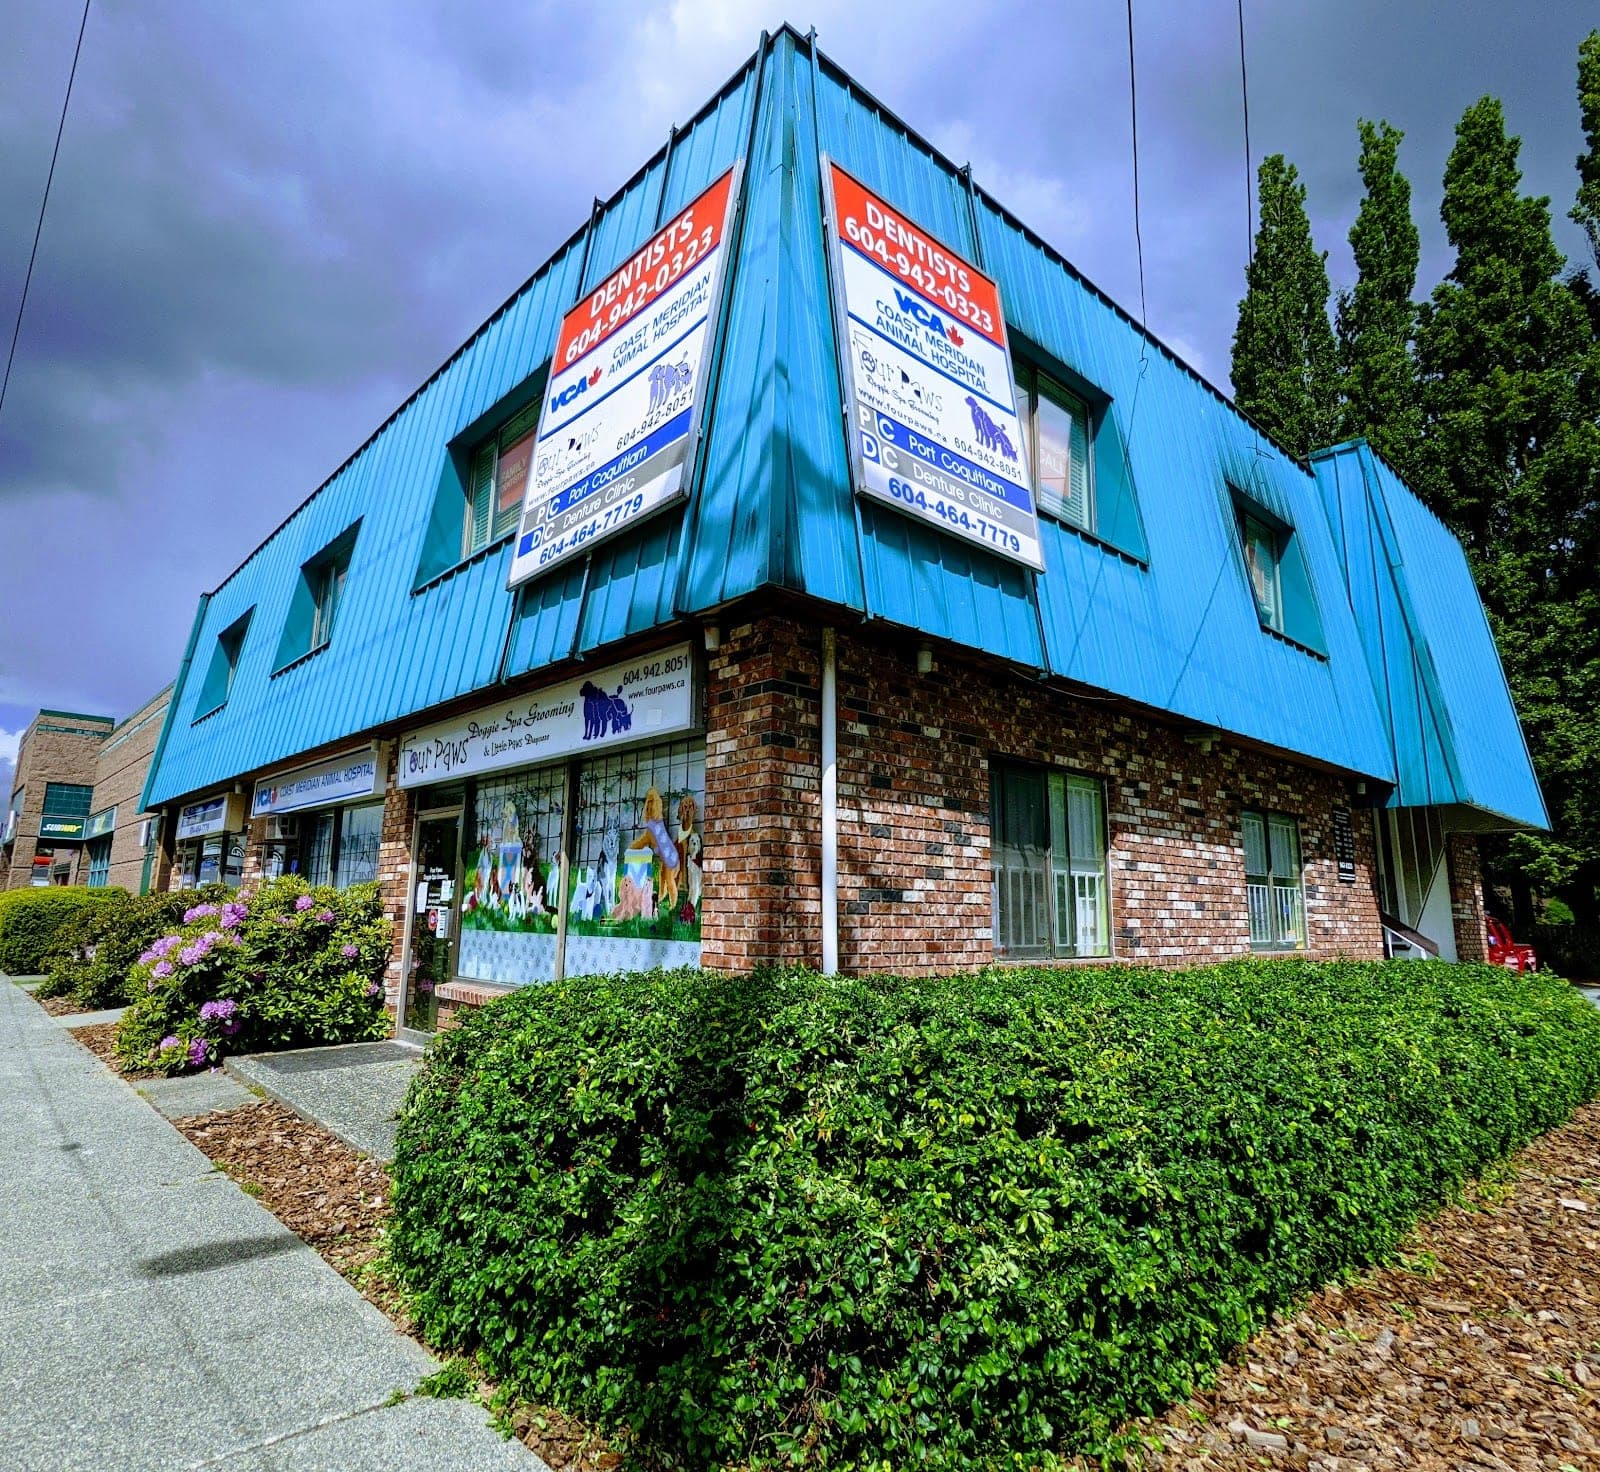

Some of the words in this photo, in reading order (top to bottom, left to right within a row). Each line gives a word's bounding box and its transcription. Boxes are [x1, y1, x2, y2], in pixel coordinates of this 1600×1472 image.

[590, 209, 694, 319] DENTISTS
[845, 216, 994, 333] 604-942-0323
[866, 201, 971, 293] DENTISTS
[565, 225, 714, 362] 604-942-0323
[612, 323, 650, 359] COAST
[652, 271, 711, 329] MERIDIAN
[893, 287, 948, 339] VCA
[607, 339, 648, 378] ANIMAL
[652, 289, 709, 343] HOSPITAL
[876, 300, 919, 337] COAST
[925, 331, 985, 377] MERIDIAN
[876, 316, 928, 357] ANIMAL
[931, 350, 990, 394] HOSPITAL
[551, 376, 588, 413] VCA
[616, 388, 693, 450] 604-942-8051
[568, 482, 589, 505] Port
[591, 445, 648, 489] Coquitlam
[860, 408, 871, 426] P
[879, 419, 895, 440] C
[909, 434, 936, 462] Port
[941, 453, 1006, 497] Coquitlam
[862, 436, 878, 459] D
[882, 447, 898, 469] C
[912, 463, 965, 501] Denture
[969, 492, 1003, 518] Clinic
[954, 437, 1022, 481] 604-942-8051
[539, 493, 644, 565] 604-464-7779
[563, 499, 601, 529] Denture
[605, 477, 636, 504] Clinic
[889, 478, 1020, 552] 604-464-7779
[623, 654, 688, 686] 604.942.8051
[628, 680, 685, 700] www.fourpaws.ca
[468, 721, 500, 739] Doggie
[502, 710, 523, 733] Spa
[523, 699, 575, 727] Grooming
[280, 783, 295, 797] COAST
[295, 777, 320, 793] MERIDIAN
[321, 771, 342, 786] ANIMAL
[344, 763, 374, 782] HOSPITAL
[43, 823, 82, 833] SUBWAY
